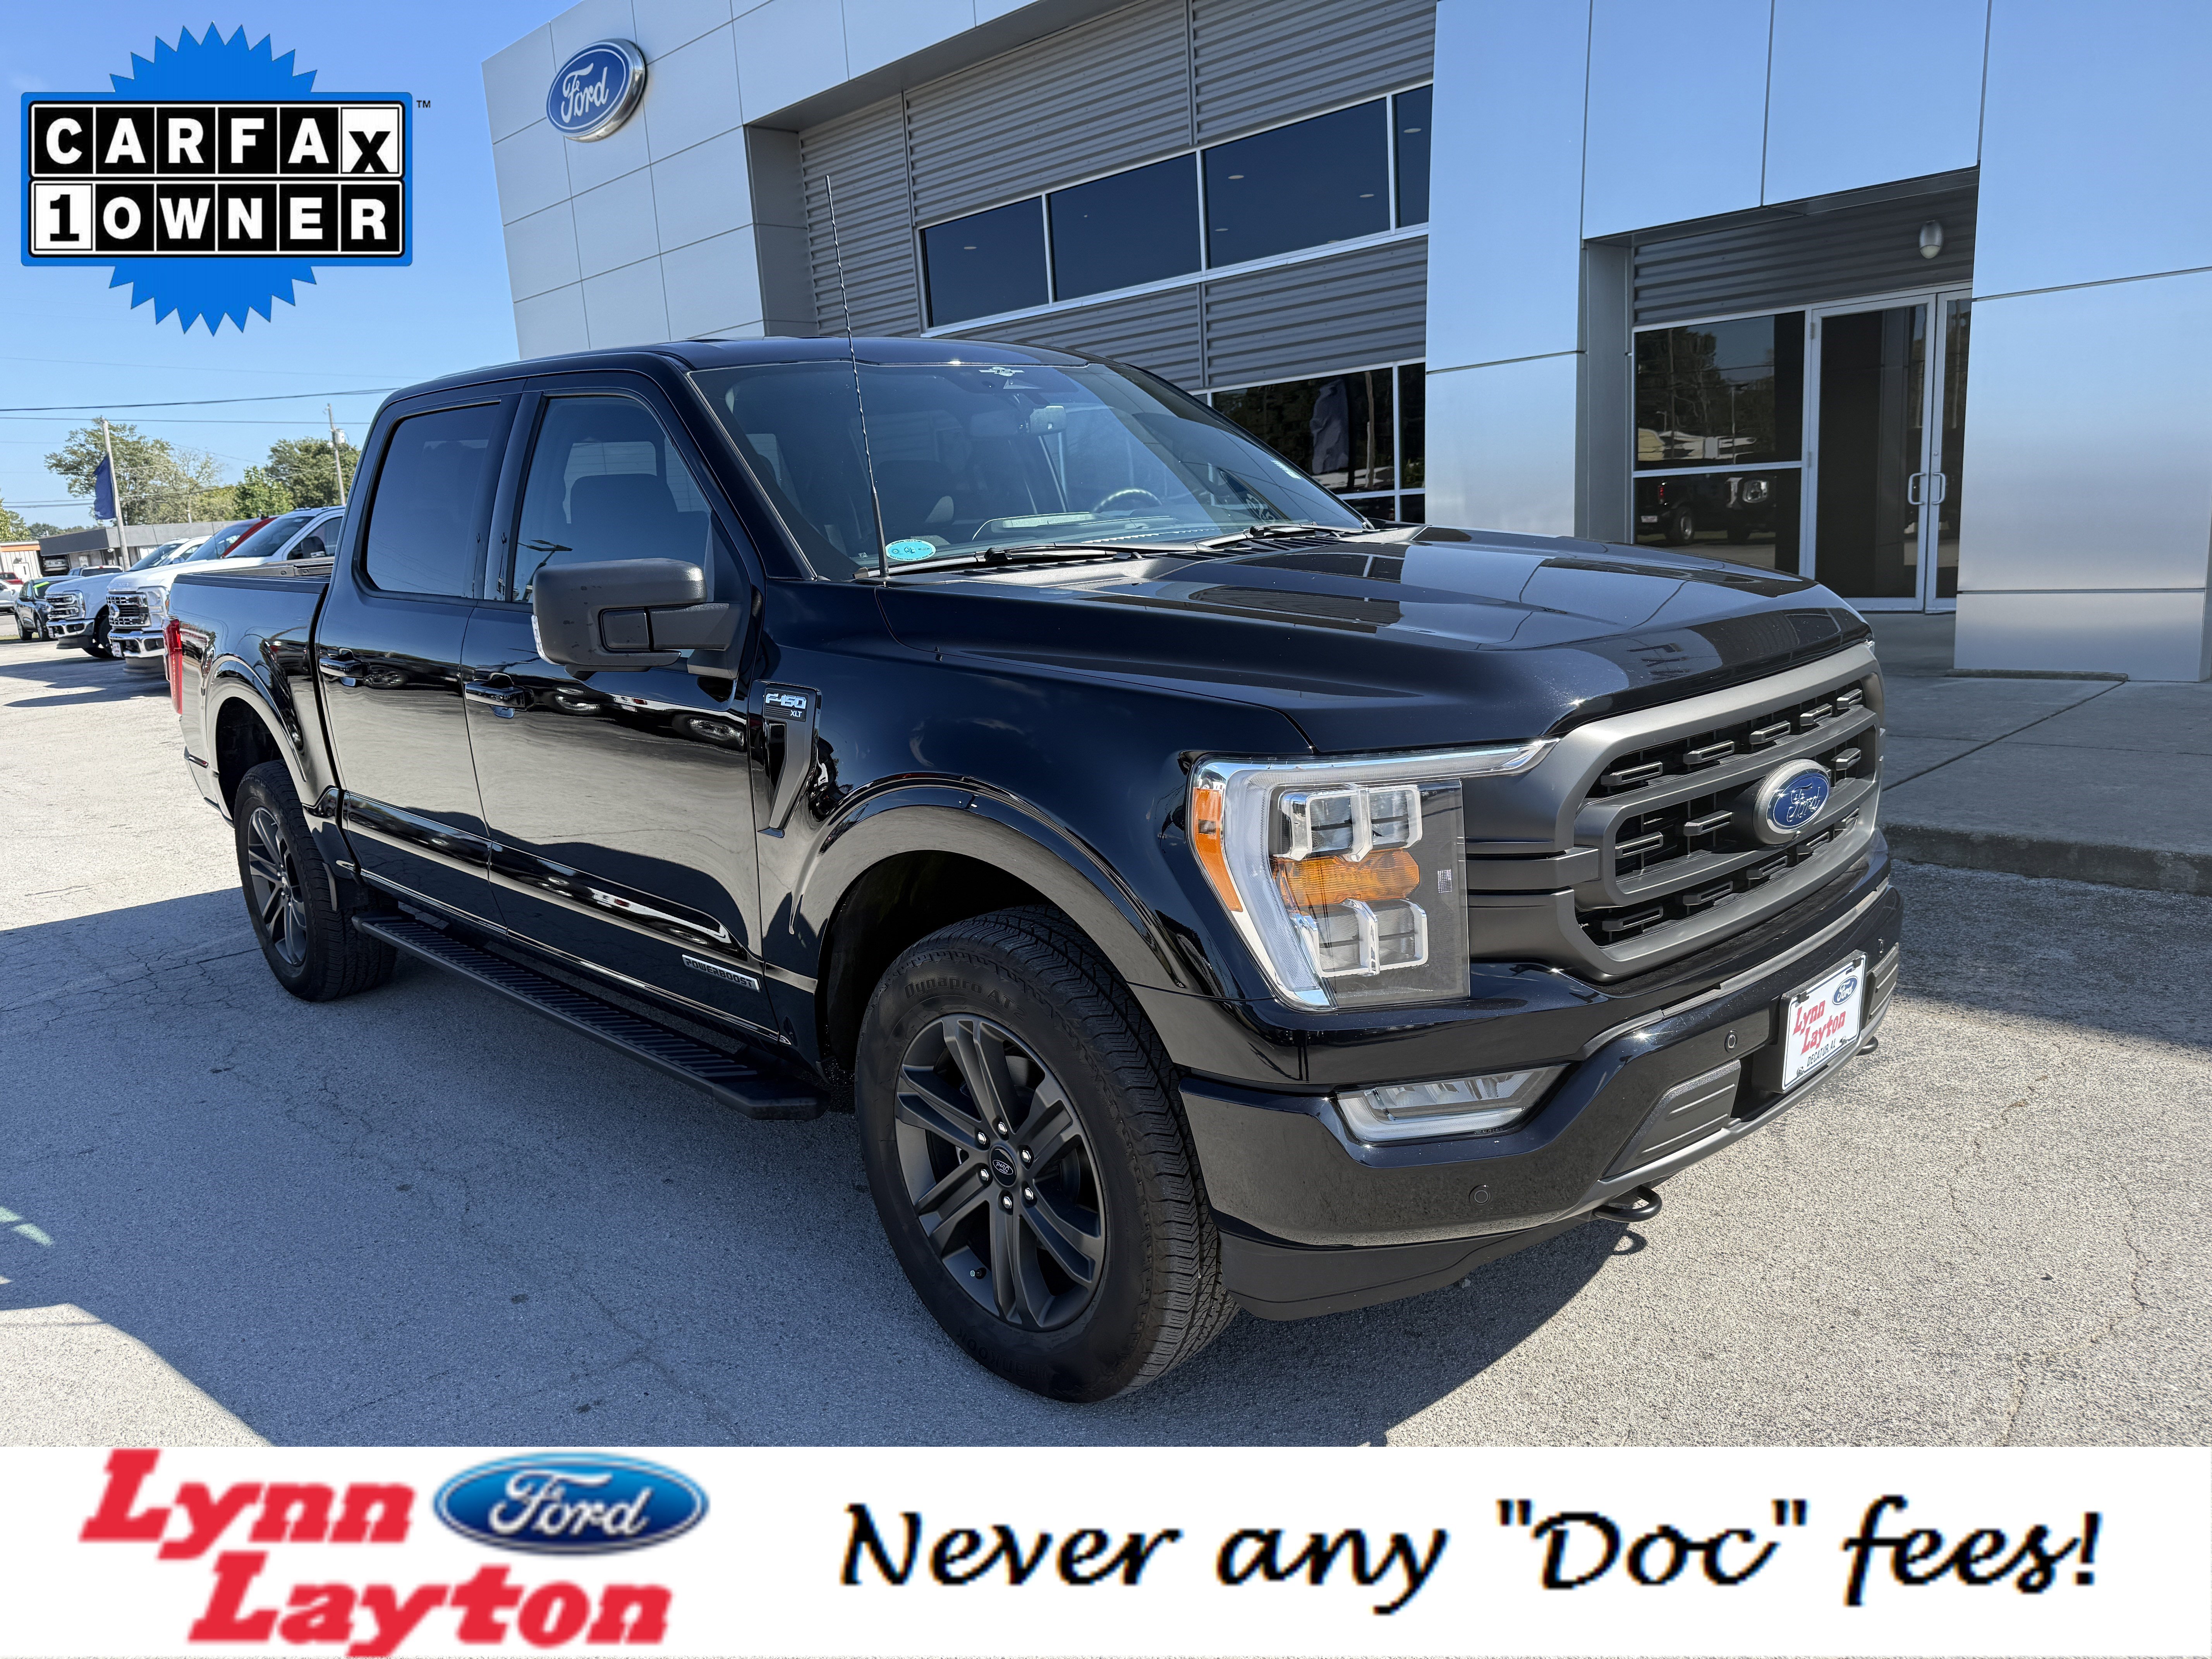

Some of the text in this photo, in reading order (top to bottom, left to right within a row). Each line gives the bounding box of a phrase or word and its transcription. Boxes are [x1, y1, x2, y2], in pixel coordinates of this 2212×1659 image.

[561, 63, 609, 123] Ford
[765, 693, 807, 709] F-150
[1786, 783, 1820, 822] Ford
[685, 958, 752, 987] POWERBOOST
[904, 977, 983, 999] Dynapro
[1837, 980, 1855, 1003] Ford
[1793, 1000, 1826, 1036] Lynn
[1801, 1011, 1846, 1055] Layton
[996, 1161, 1009, 1173] Ford
